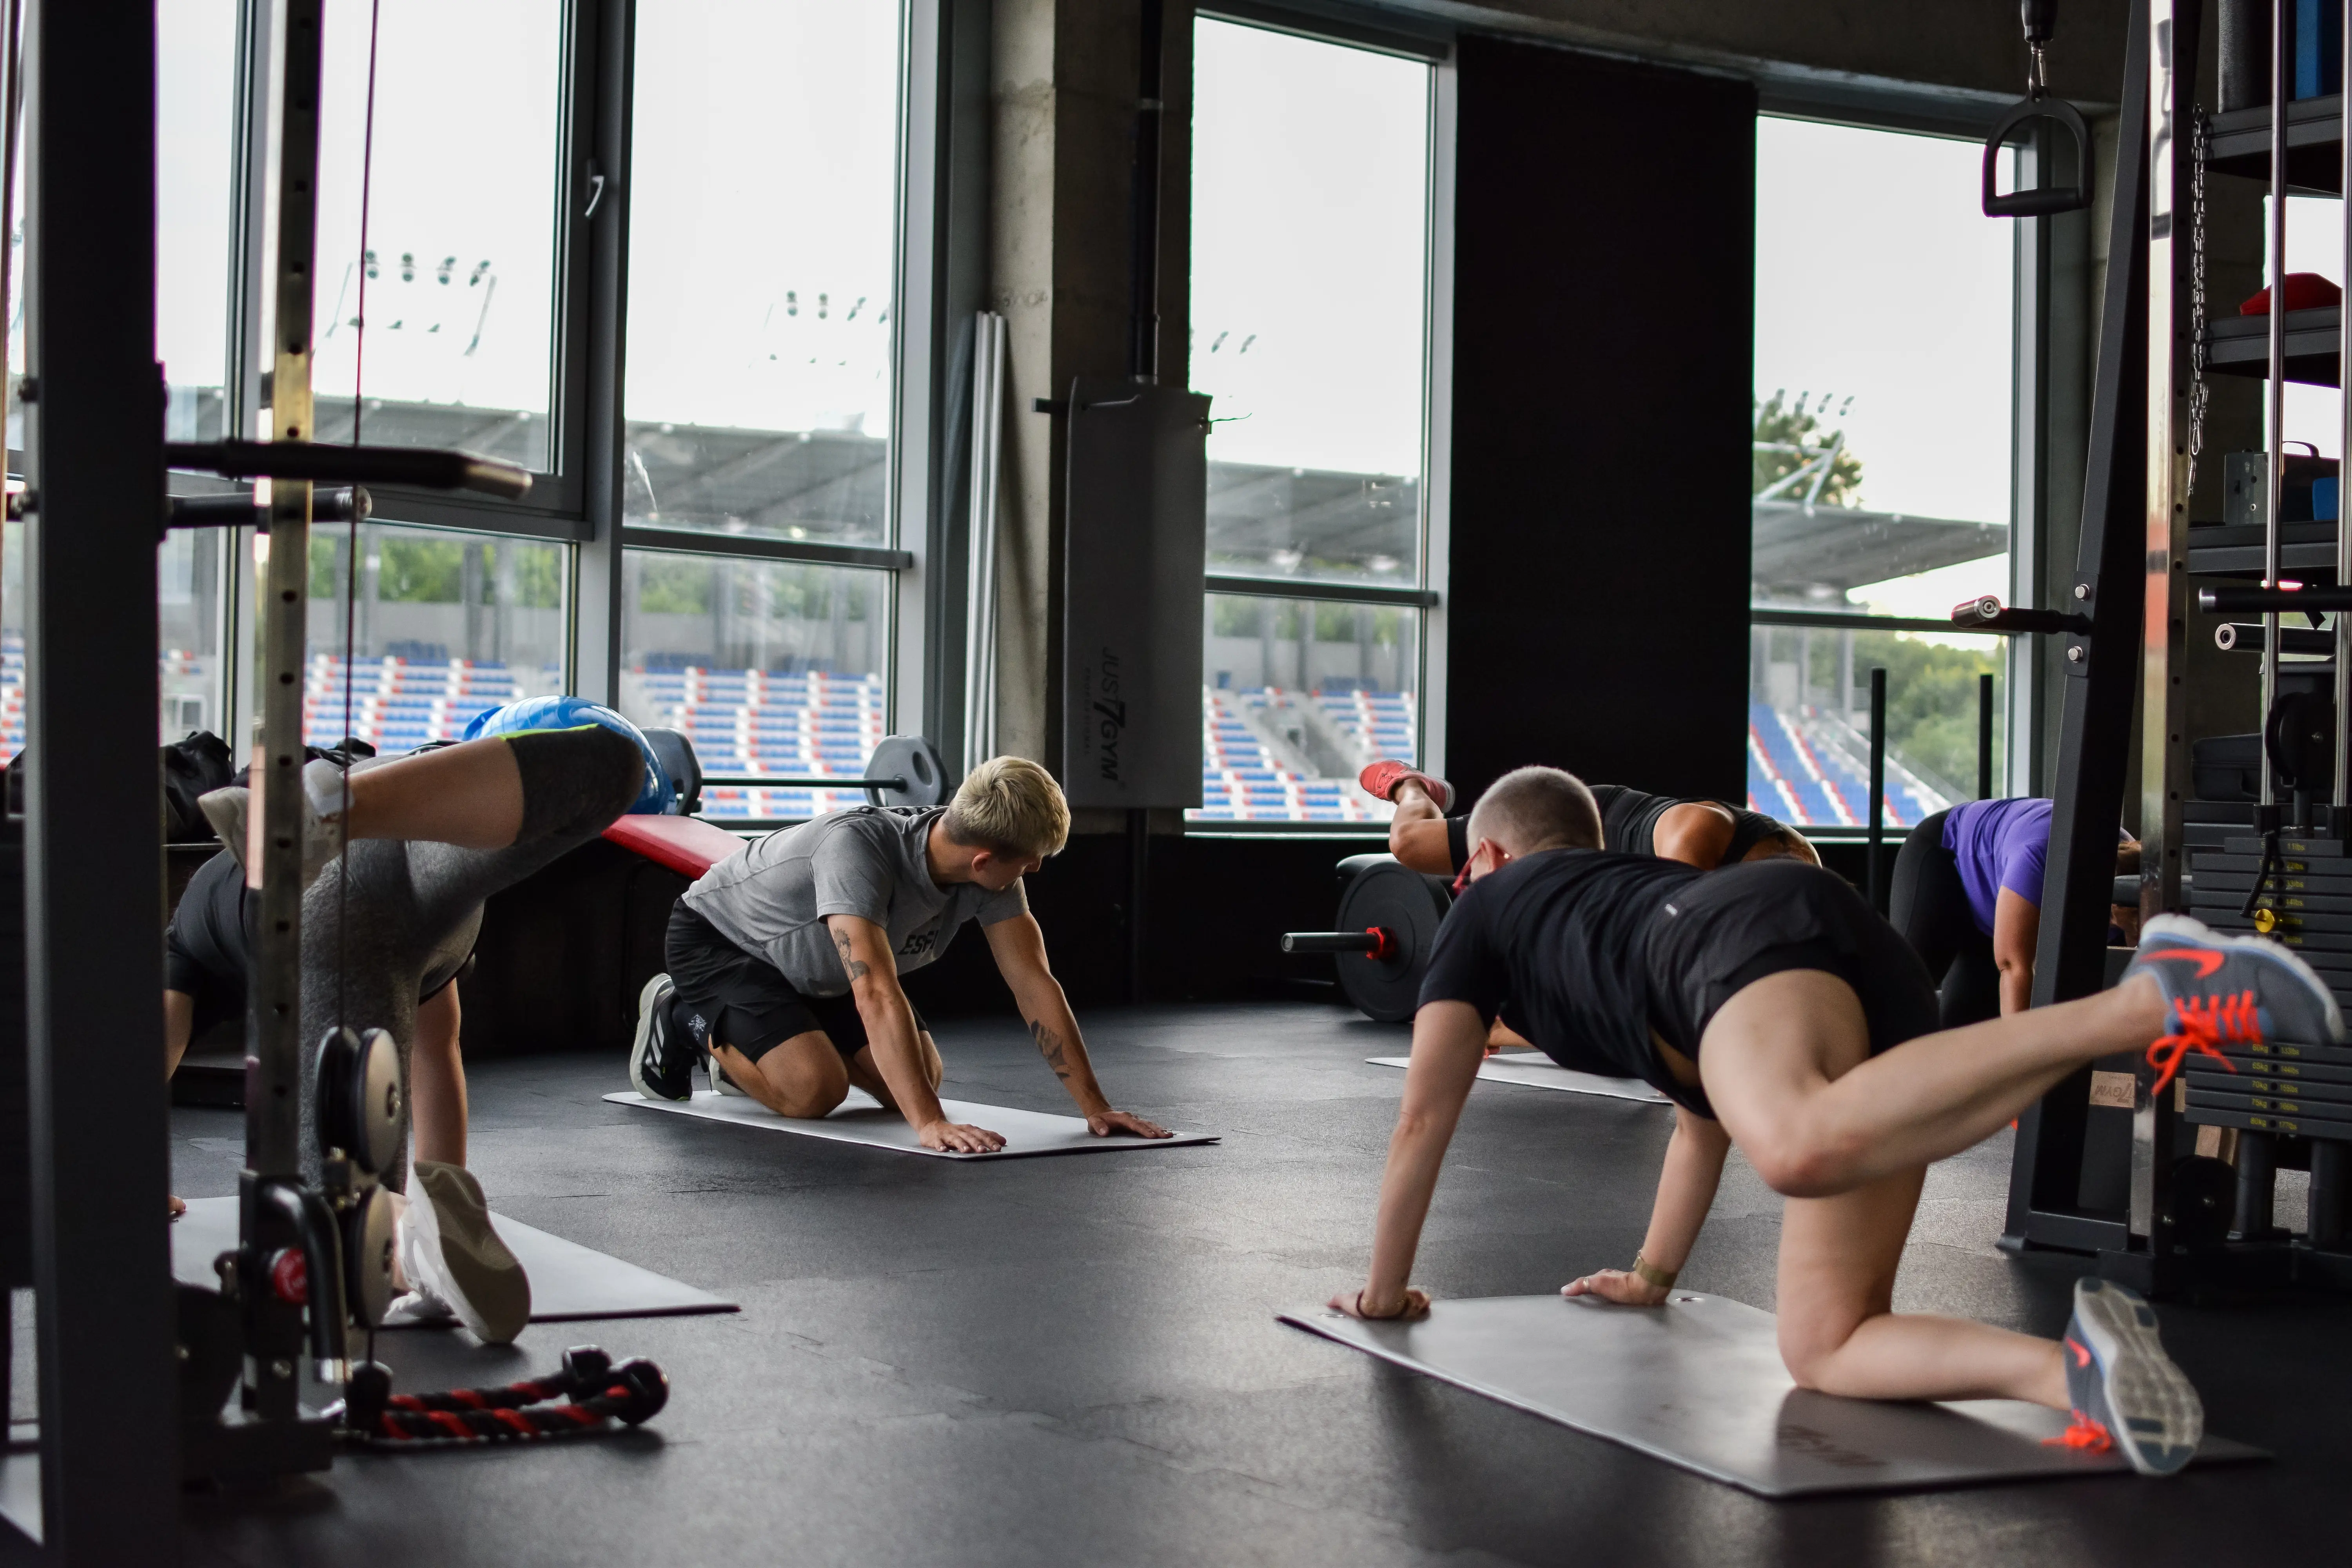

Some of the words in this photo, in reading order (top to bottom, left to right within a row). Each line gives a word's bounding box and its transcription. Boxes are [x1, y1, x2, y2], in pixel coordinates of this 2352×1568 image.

[2257, 897, 2273, 907] 20kg
[2252, 1044, 2268, 1054] 60kg
[2252, 1062, 2268, 1072] 65kg
[2252, 1080, 2268, 1091] 70kg
[2252, 1098, 2267, 1109] 75kg
